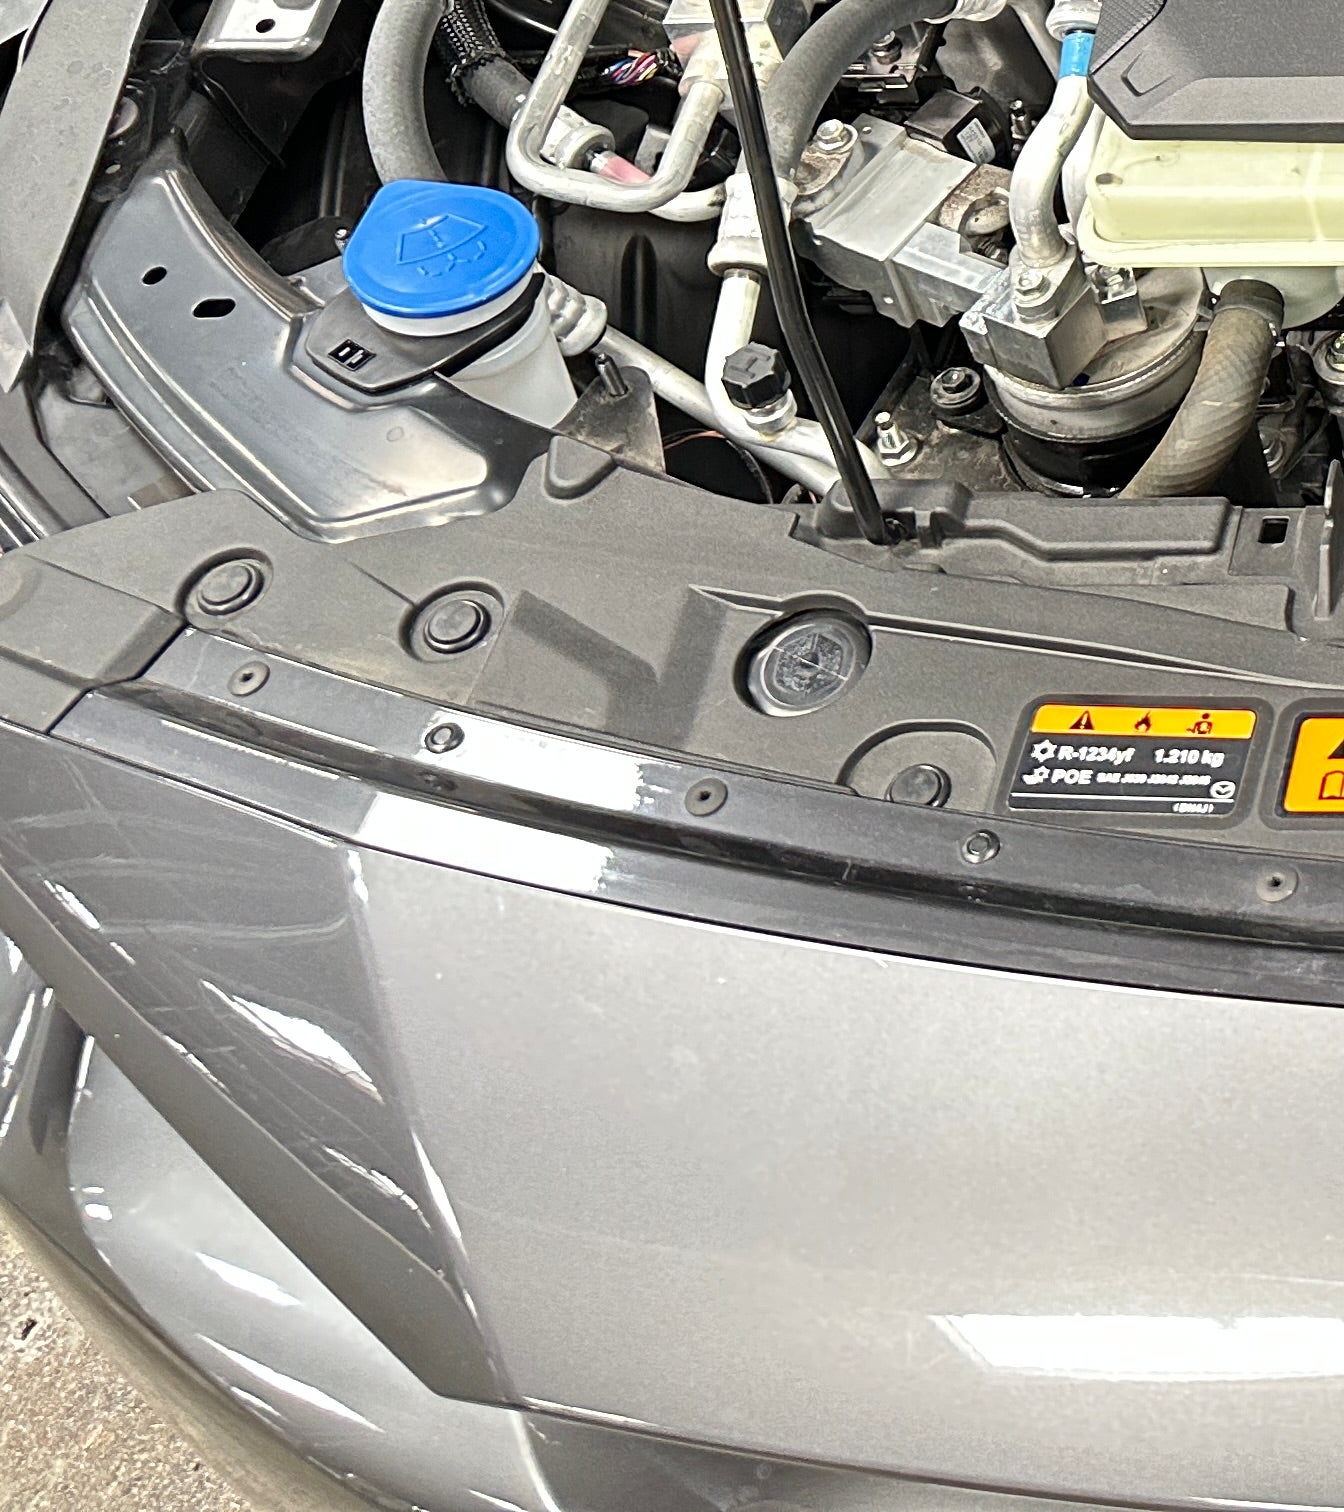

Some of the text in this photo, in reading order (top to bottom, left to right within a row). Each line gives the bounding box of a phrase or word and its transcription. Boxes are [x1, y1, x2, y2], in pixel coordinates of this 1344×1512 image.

[1056, 745, 1136, 766] R-1234yf
[1201, 750, 1225, 768] kg
[1050, 767, 1094, 785] POE
